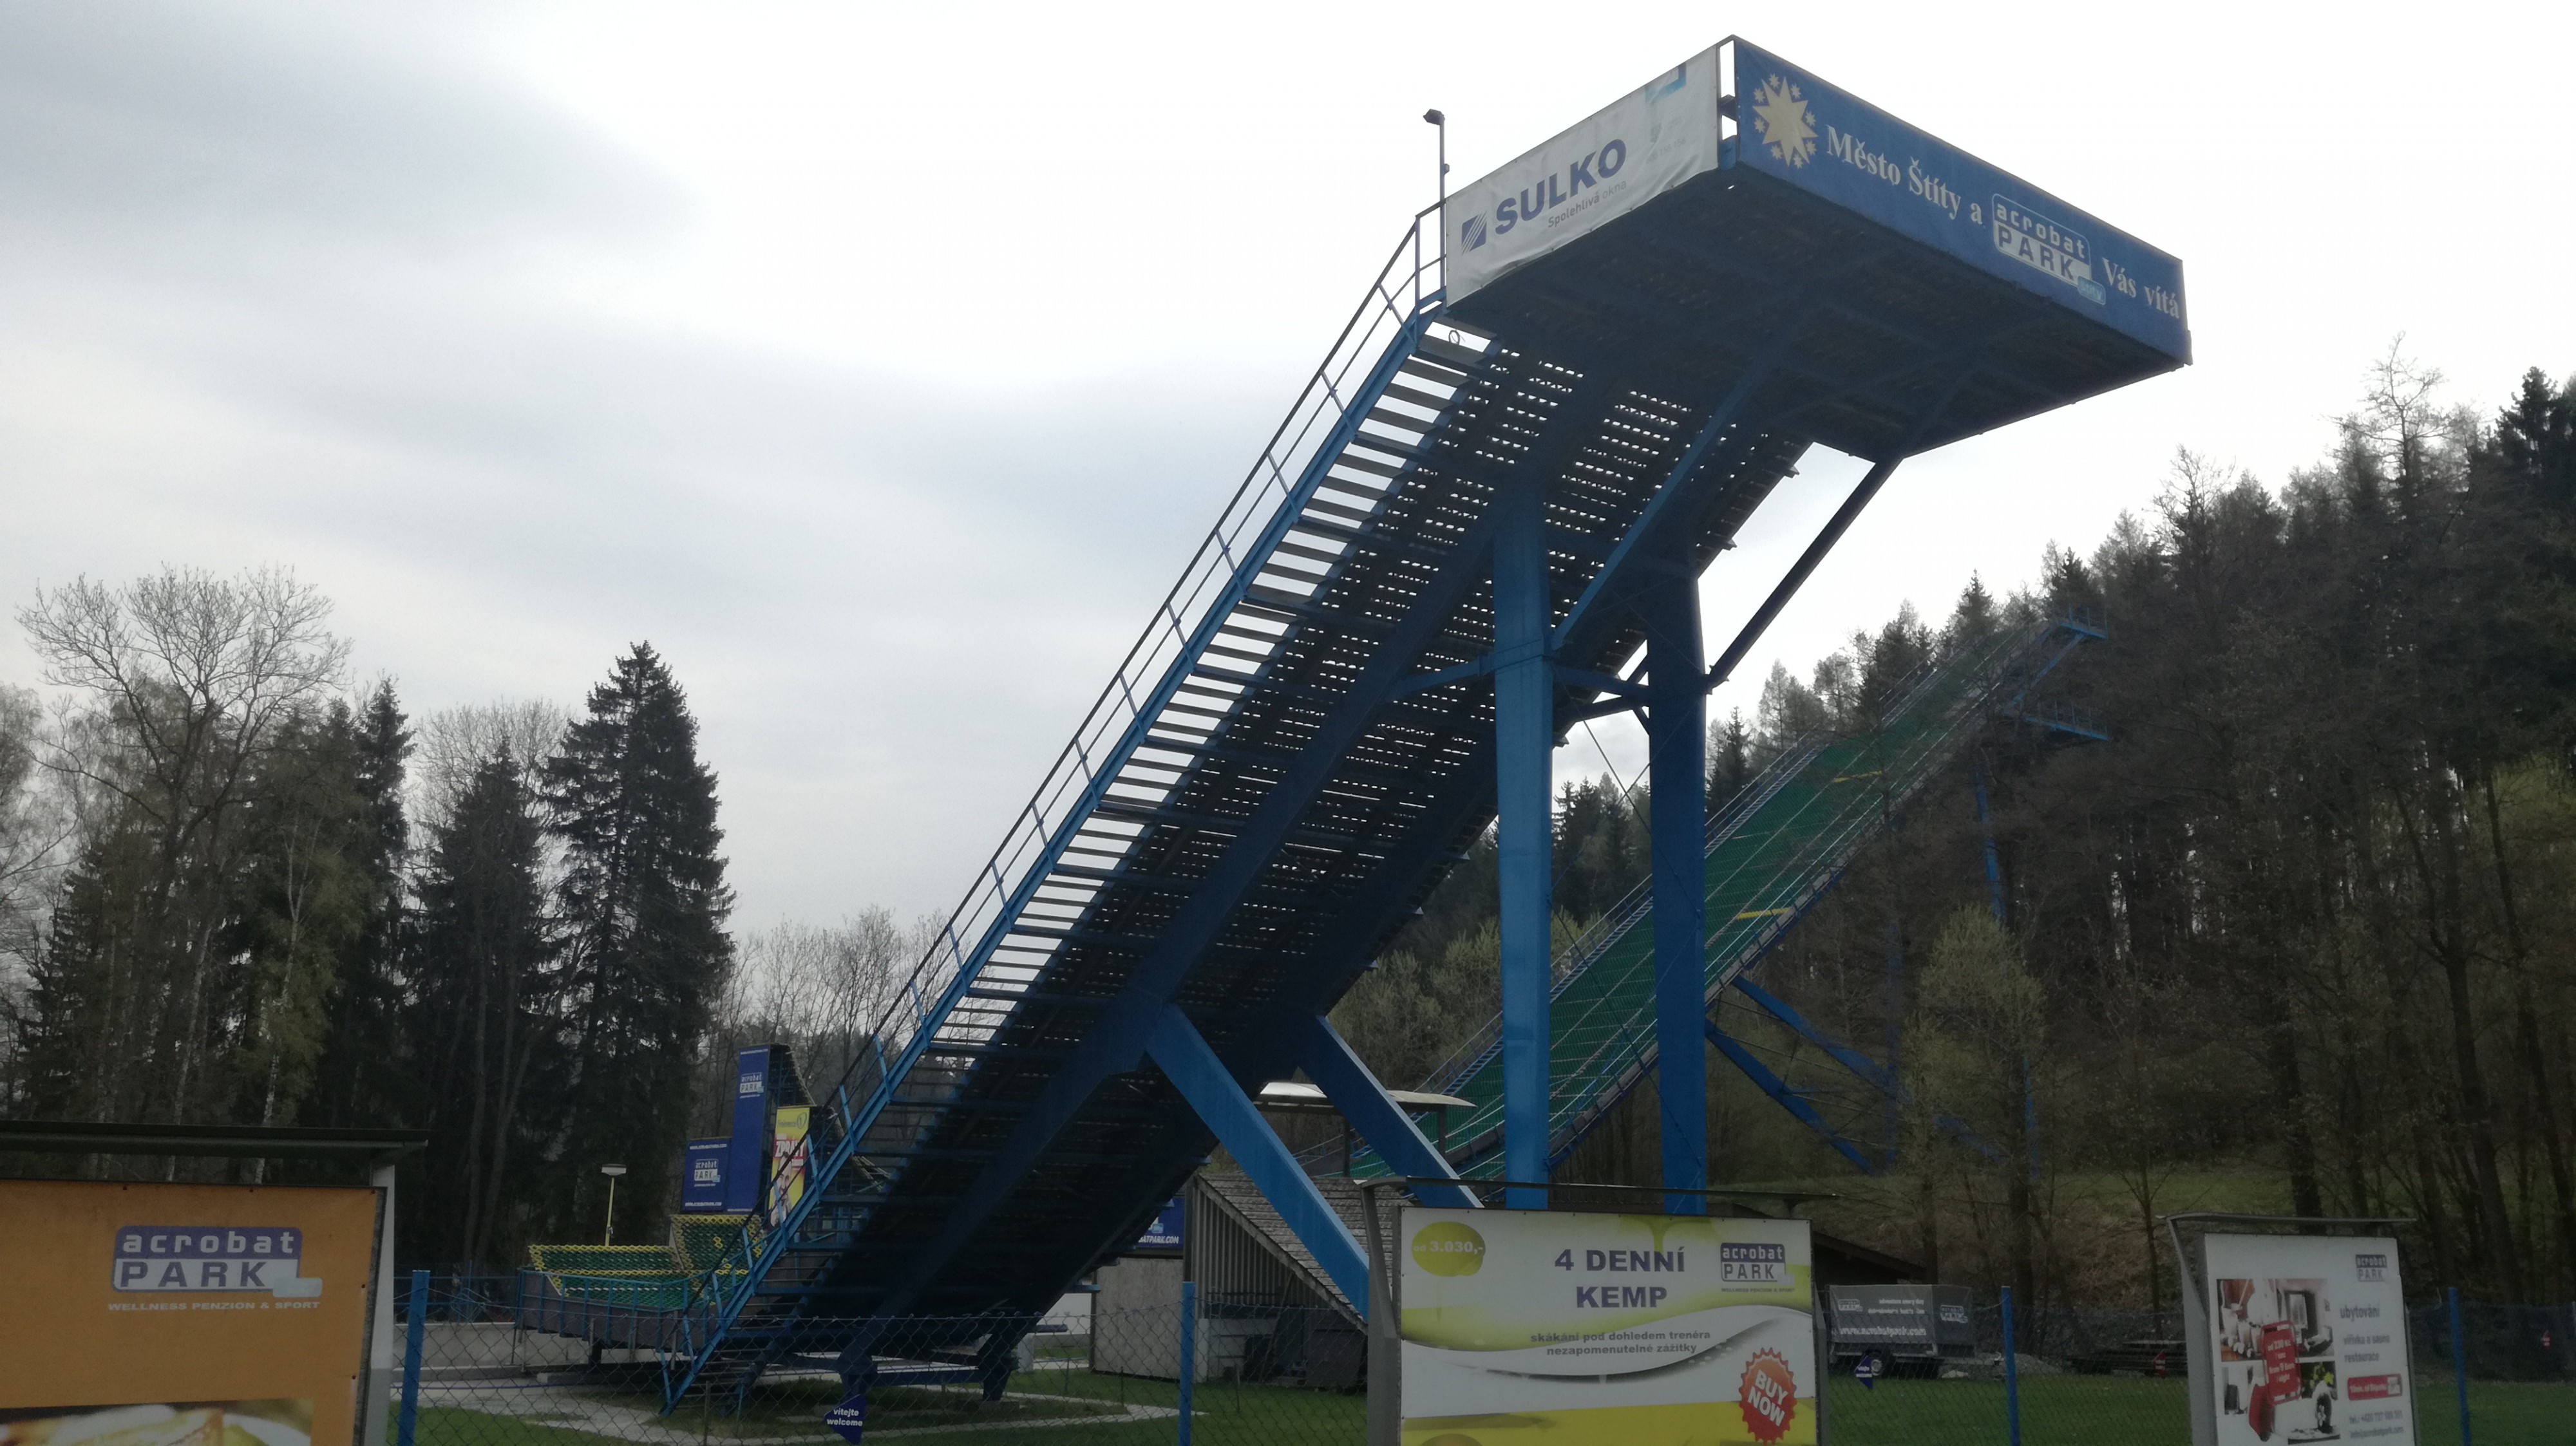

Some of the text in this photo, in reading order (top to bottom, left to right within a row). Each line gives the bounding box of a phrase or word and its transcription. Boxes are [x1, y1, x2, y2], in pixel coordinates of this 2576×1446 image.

[1825, 124, 1983, 225] Město Štíty a
[1495, 138, 1627, 235] SULKO
[1548, 180, 1627, 229] Spolehlivá okna
[1996, 203, 2085, 259] acrobat
[1997, 224, 2076, 282] PARK
[2102, 257, 2180, 319] Vás vítá
[695, 1170, 713, 1179] PARK
[122, 1231, 294, 1254] acrobat
[1413, 1241, 1484, 1255] od 3.030,-
[1722, 1246, 1783, 1261] acrobat
[1554, 1246, 1685, 1272] 4 DENNÍ
[2356, 1256, 2386, 1266] acrobat
[119, 1261, 267, 1288] PARK
[1724, 1263, 1775, 1279] PARK
[2358, 1268, 2384, 1280] PARK
[108, 1300, 321, 1311] WELLNESS PENZION & SPORT
[1576, 1286, 1668, 1308] KEMP
[1530, 1330, 1710, 1343] skákání pod dohledem trenéra
[1546, 1343, 1697, 1357] nezapomenutelné zážitky
[1755, 1369, 1788, 1405] BUY
[1747, 1386, 1786, 1427] NOW
[826, 1418, 863, 1427] welcome
